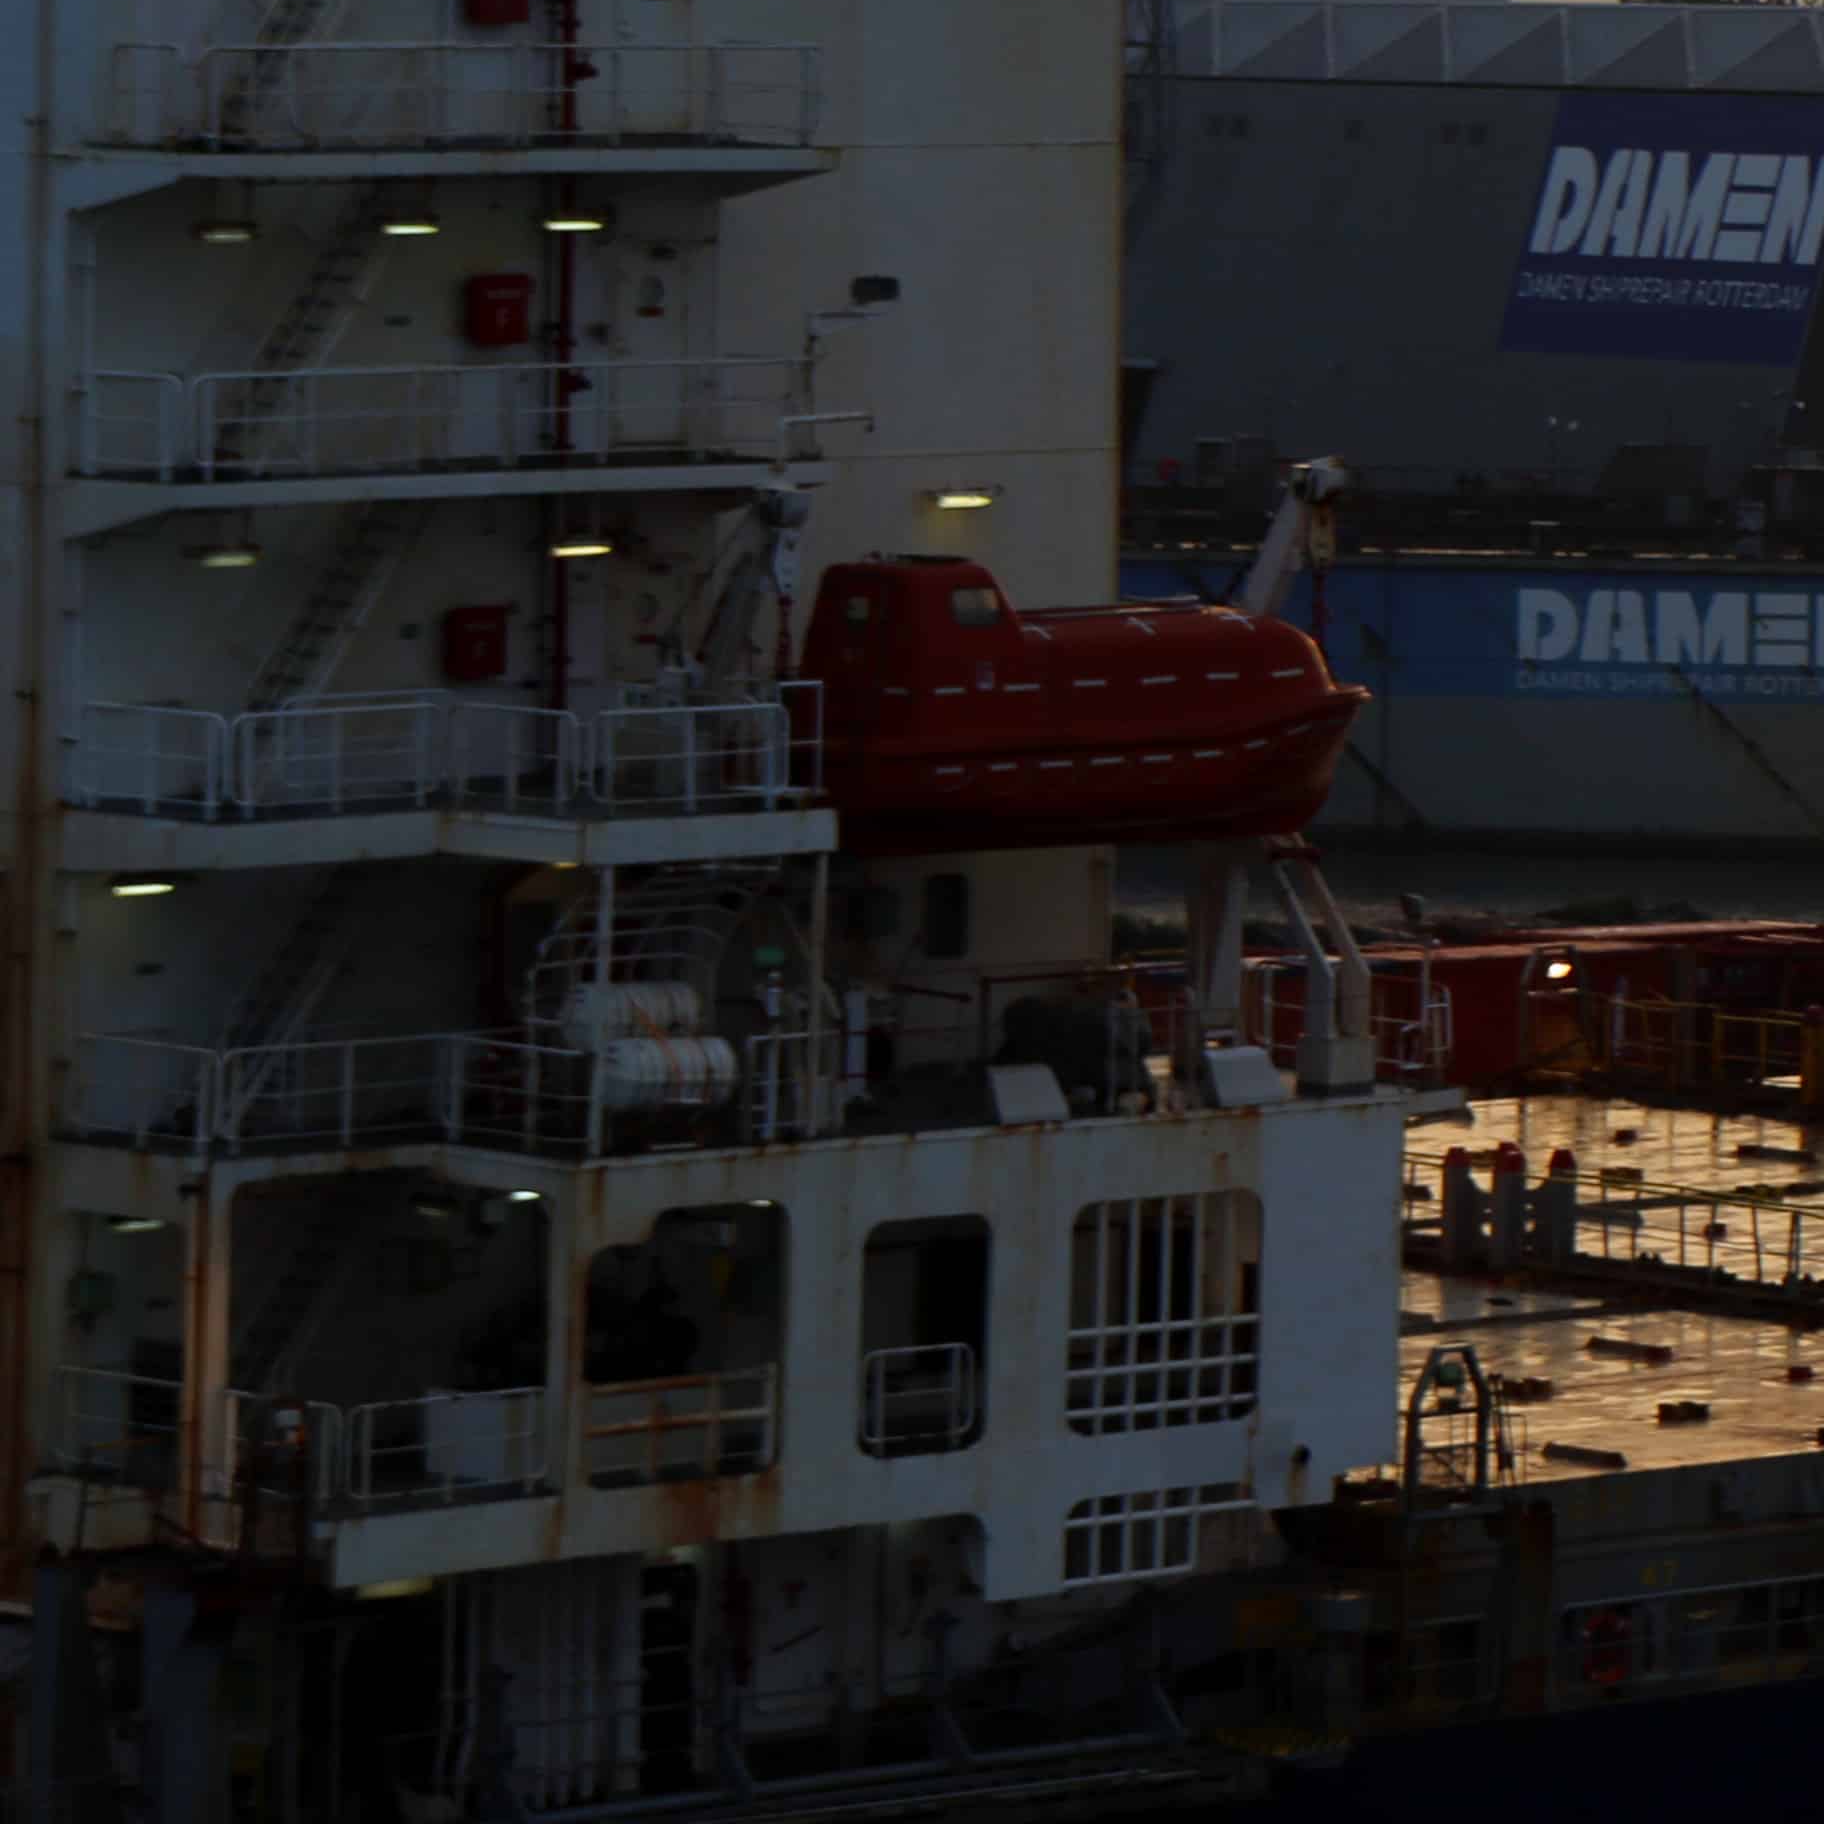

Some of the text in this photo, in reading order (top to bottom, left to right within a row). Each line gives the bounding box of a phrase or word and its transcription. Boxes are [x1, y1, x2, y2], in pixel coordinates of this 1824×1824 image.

[1516, 271, 1586, 304] DAMEN
[1687, 278, 1811, 312] ROTTERDAM
[1514, 670, 1601, 690] DAMEN
